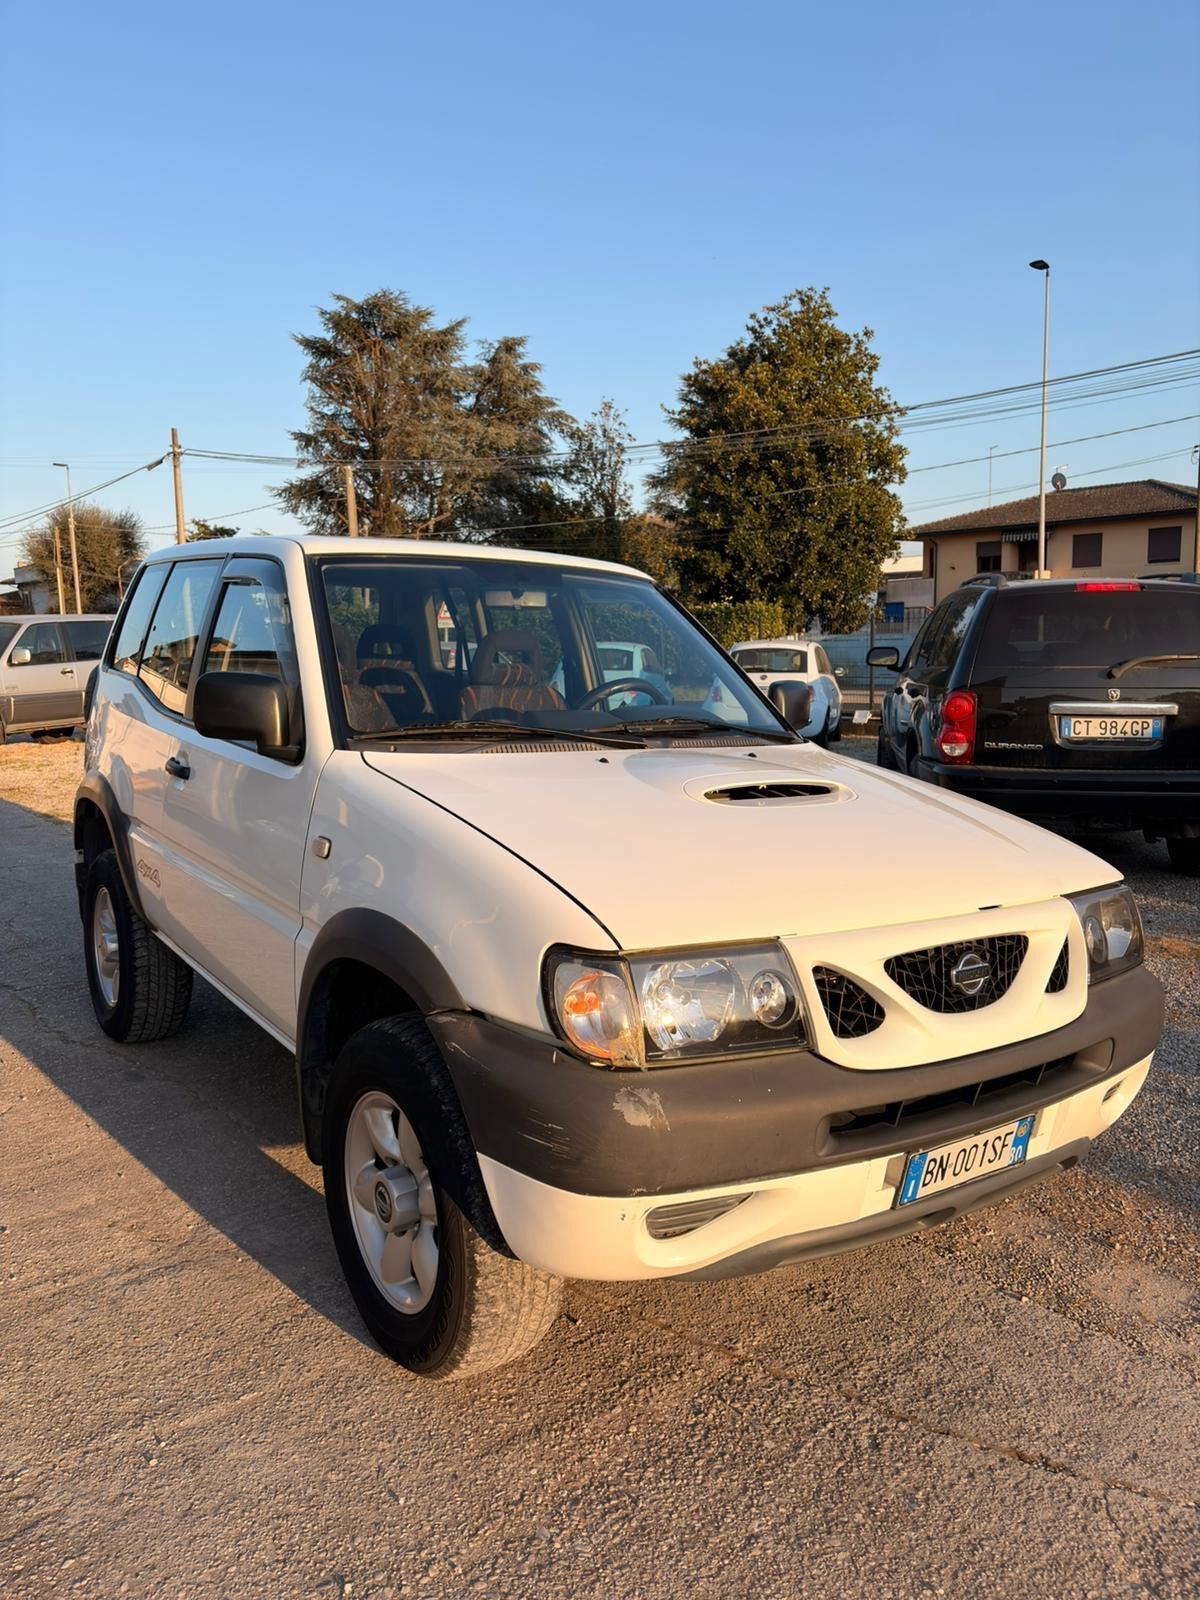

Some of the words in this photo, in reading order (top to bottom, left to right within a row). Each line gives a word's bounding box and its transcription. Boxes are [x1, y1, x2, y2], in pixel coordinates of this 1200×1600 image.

[1073, 720, 1092, 736] CT
[1099, 720, 1150, 737] 984GP
[984, 741, 1044, 750] DURANGO
